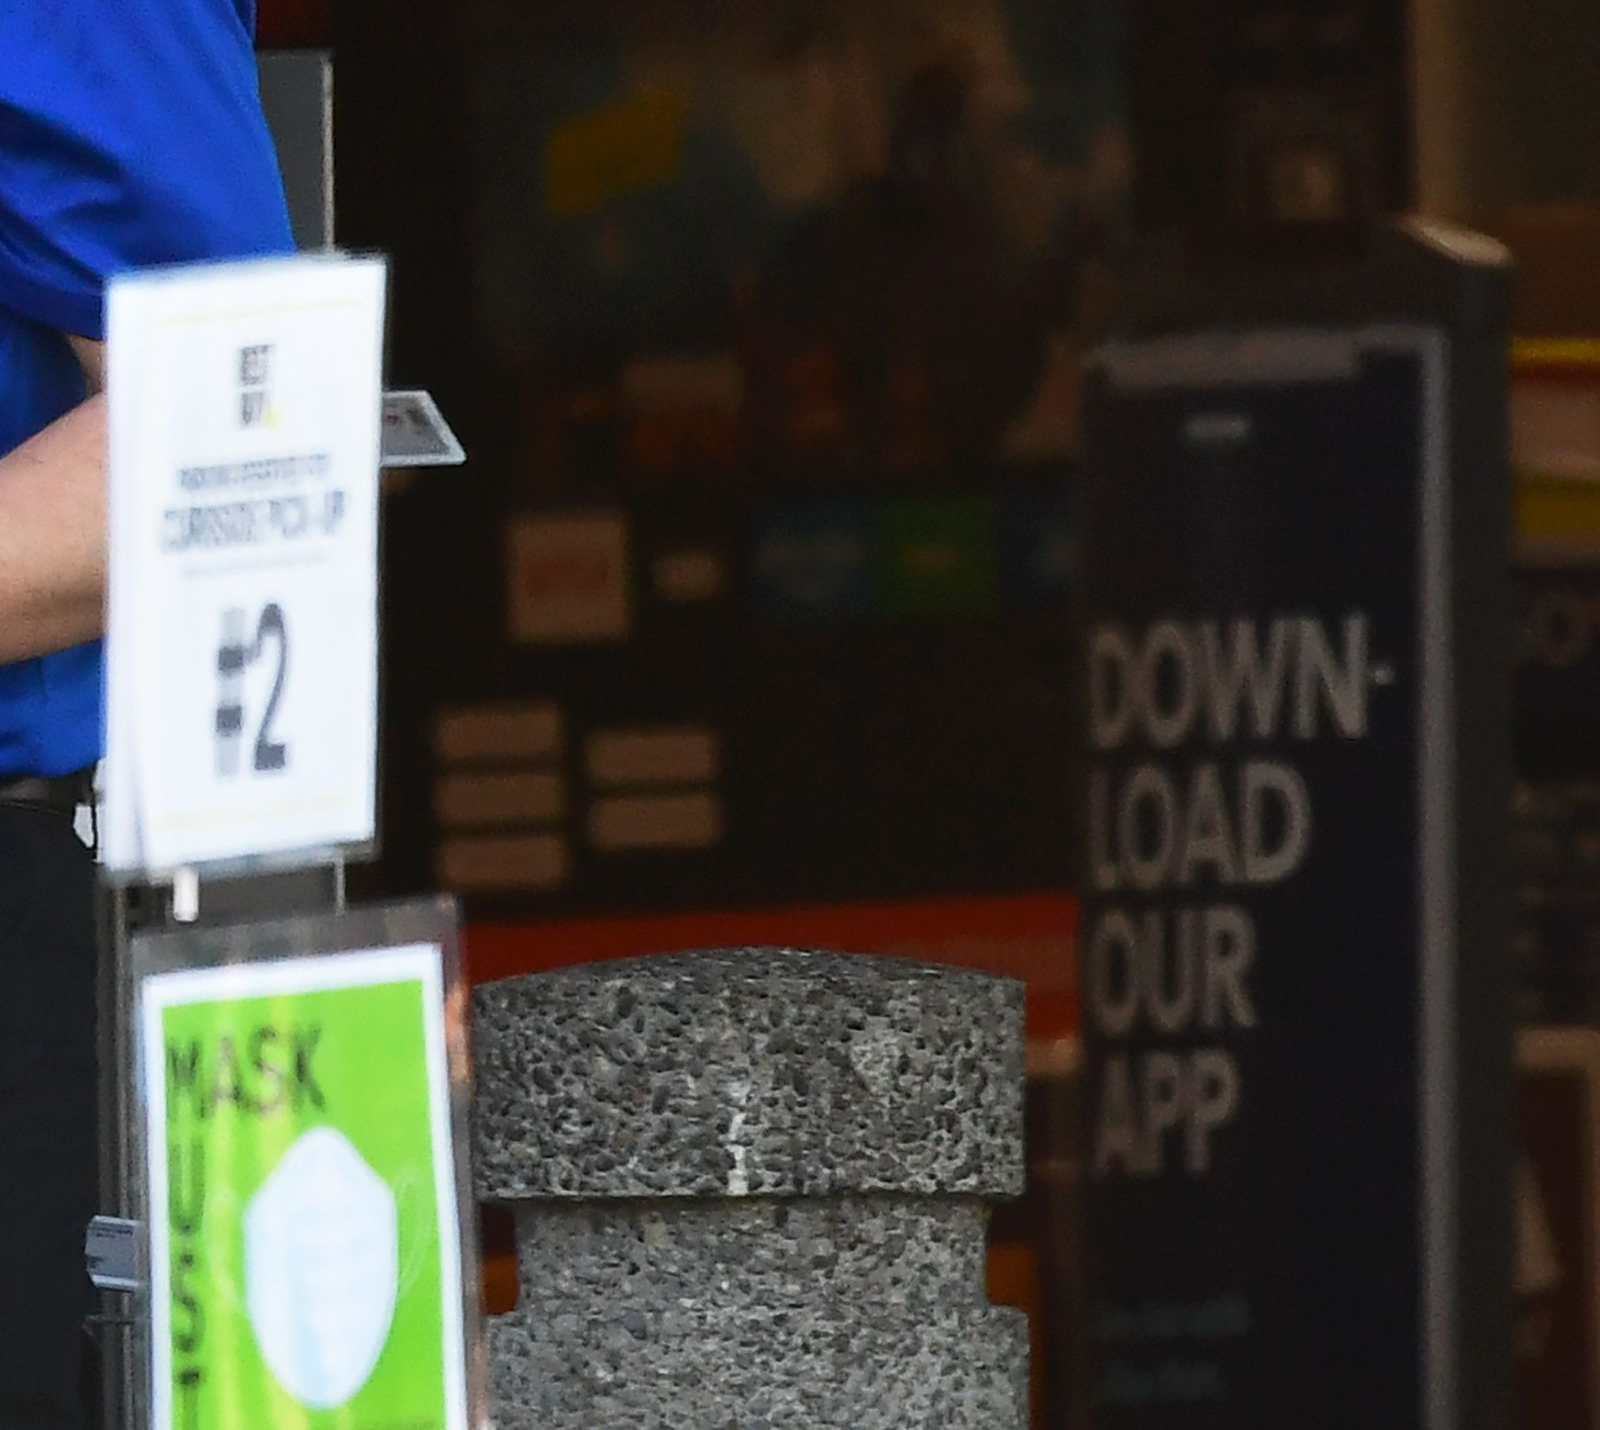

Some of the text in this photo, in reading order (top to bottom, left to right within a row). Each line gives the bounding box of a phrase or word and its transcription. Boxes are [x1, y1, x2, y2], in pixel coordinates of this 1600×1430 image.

[214, 601, 288, 776] #2
[1092, 614, 1395, 749] DOWN-
[1090, 761, 1312, 890] LOAD
[1092, 904, 1257, 1034] OUR
[166, 1022, 326, 1121] MASK
[1094, 1047, 1241, 1176] APP
